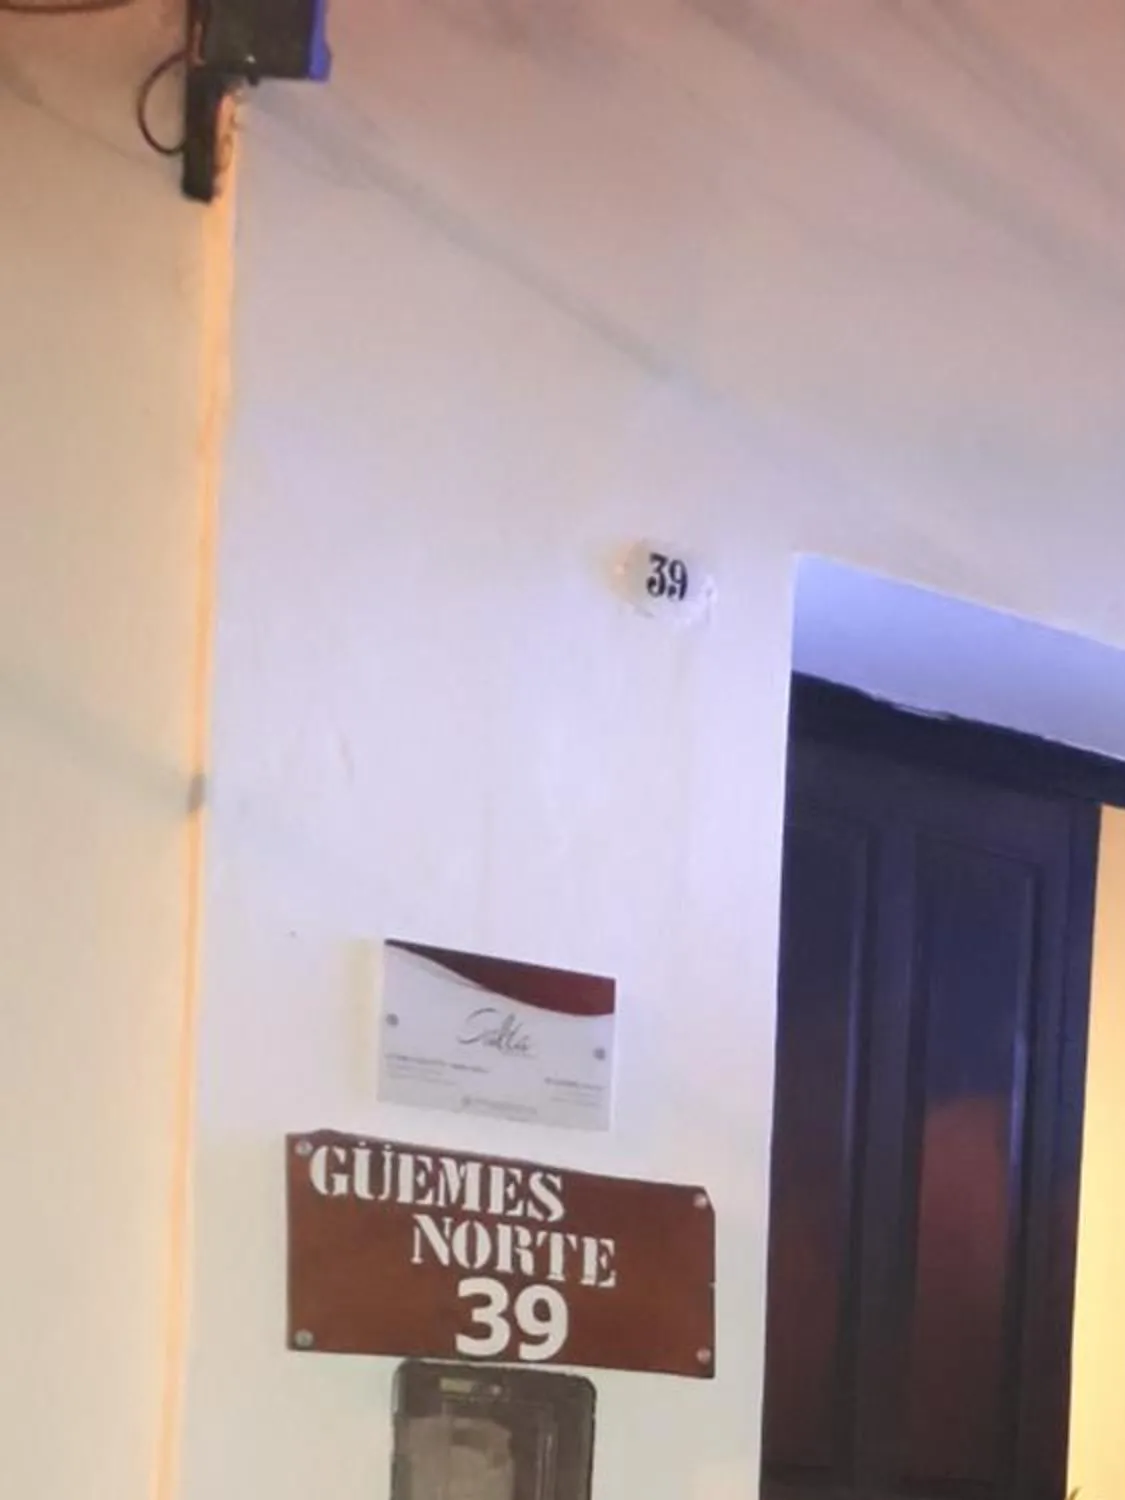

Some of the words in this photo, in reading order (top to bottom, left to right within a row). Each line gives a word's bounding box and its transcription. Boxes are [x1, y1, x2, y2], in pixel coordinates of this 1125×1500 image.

[646, 552, 688, 601] 39
[308, 1140, 565, 1223] GÜEMES
[411, 1214, 617, 1288] NORTE
[454, 1278, 569, 1361] 39
